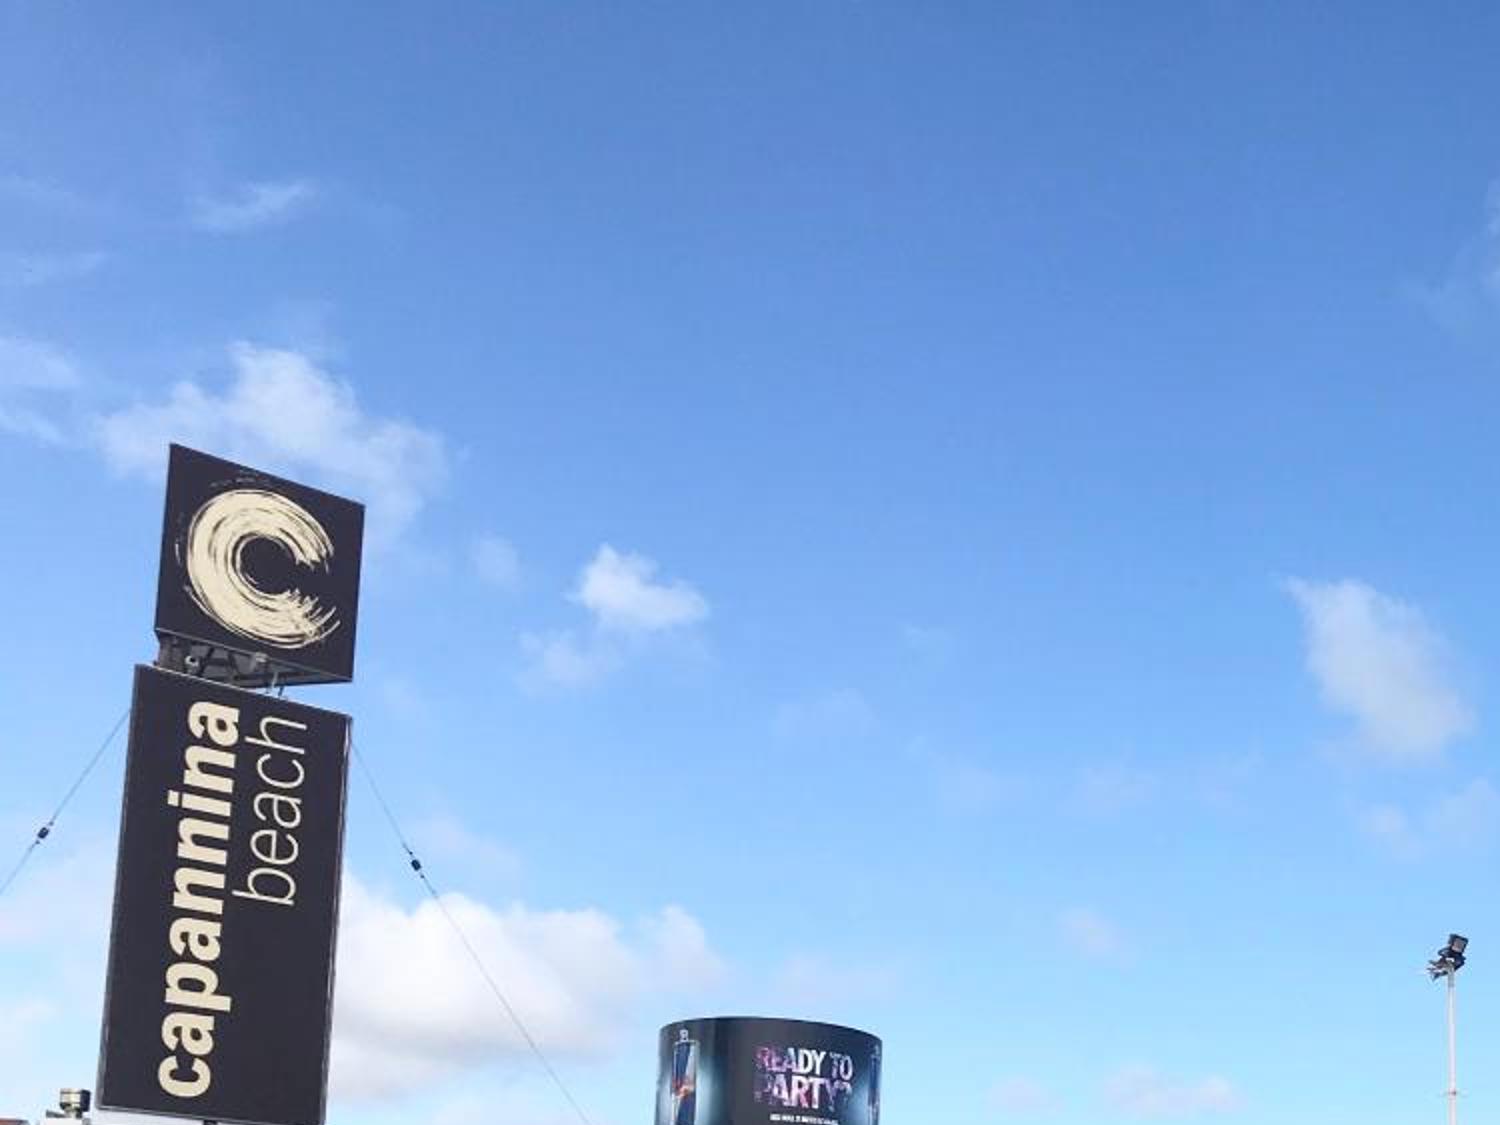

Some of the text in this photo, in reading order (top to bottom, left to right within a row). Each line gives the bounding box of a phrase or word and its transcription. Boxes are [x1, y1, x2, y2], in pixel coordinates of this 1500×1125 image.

[157, 700, 241, 1098] capannina
[231, 715, 308, 907] beach
[755, 1047, 854, 1081] READY TO
